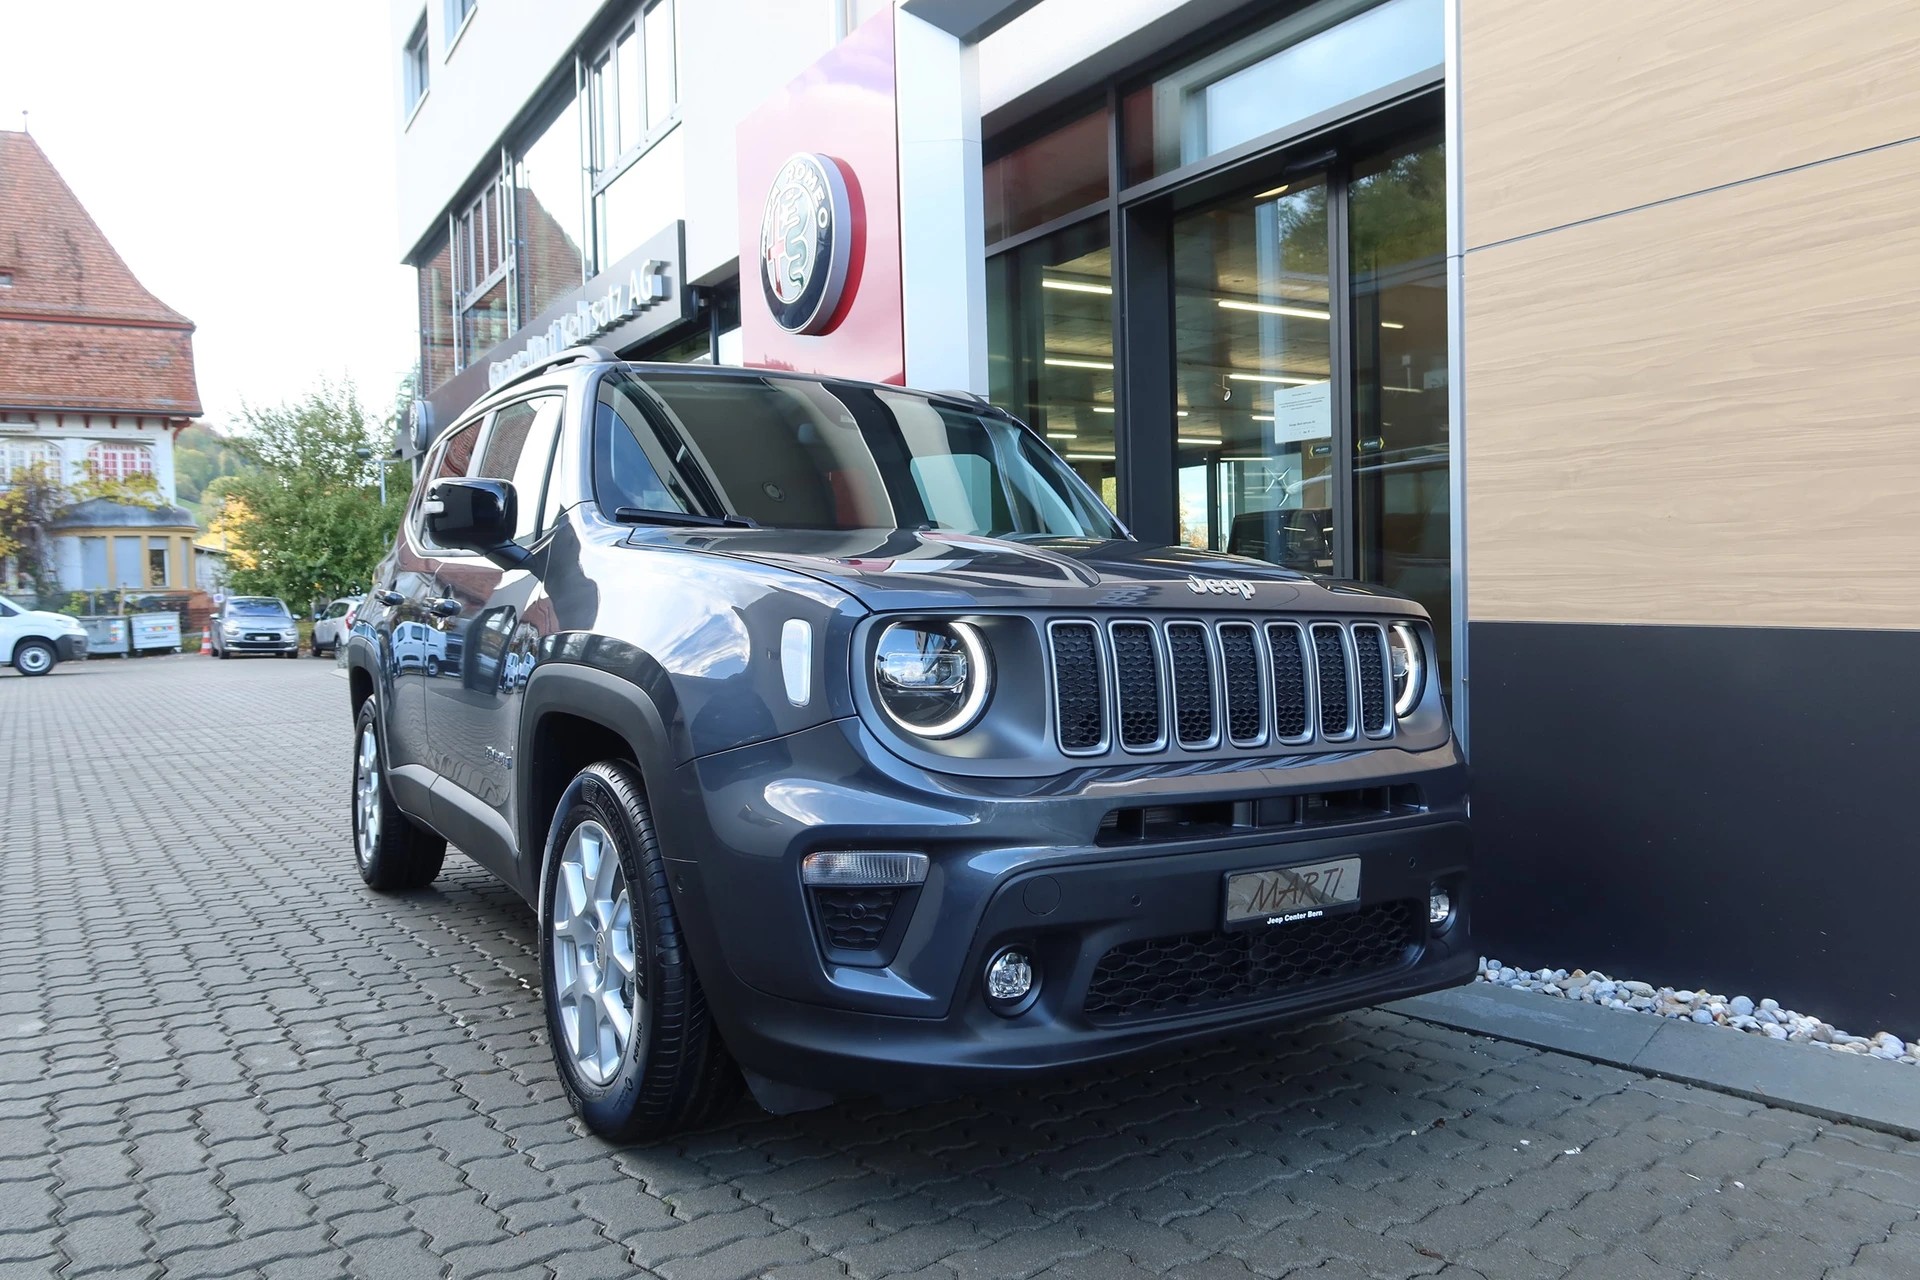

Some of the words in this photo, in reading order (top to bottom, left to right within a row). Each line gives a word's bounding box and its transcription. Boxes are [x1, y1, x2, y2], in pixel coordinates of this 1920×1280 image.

[785, 162, 828, 229] ROMEO
[628, 259, 662, 311] AG
[1186, 574, 1256, 600] Jeep
[1246, 867, 1344, 913] MARTI
[1266, 917, 1284, 925] Jeep
[1284, 912, 1307, 922] Center
[1307, 910, 1323, 919] Bern
